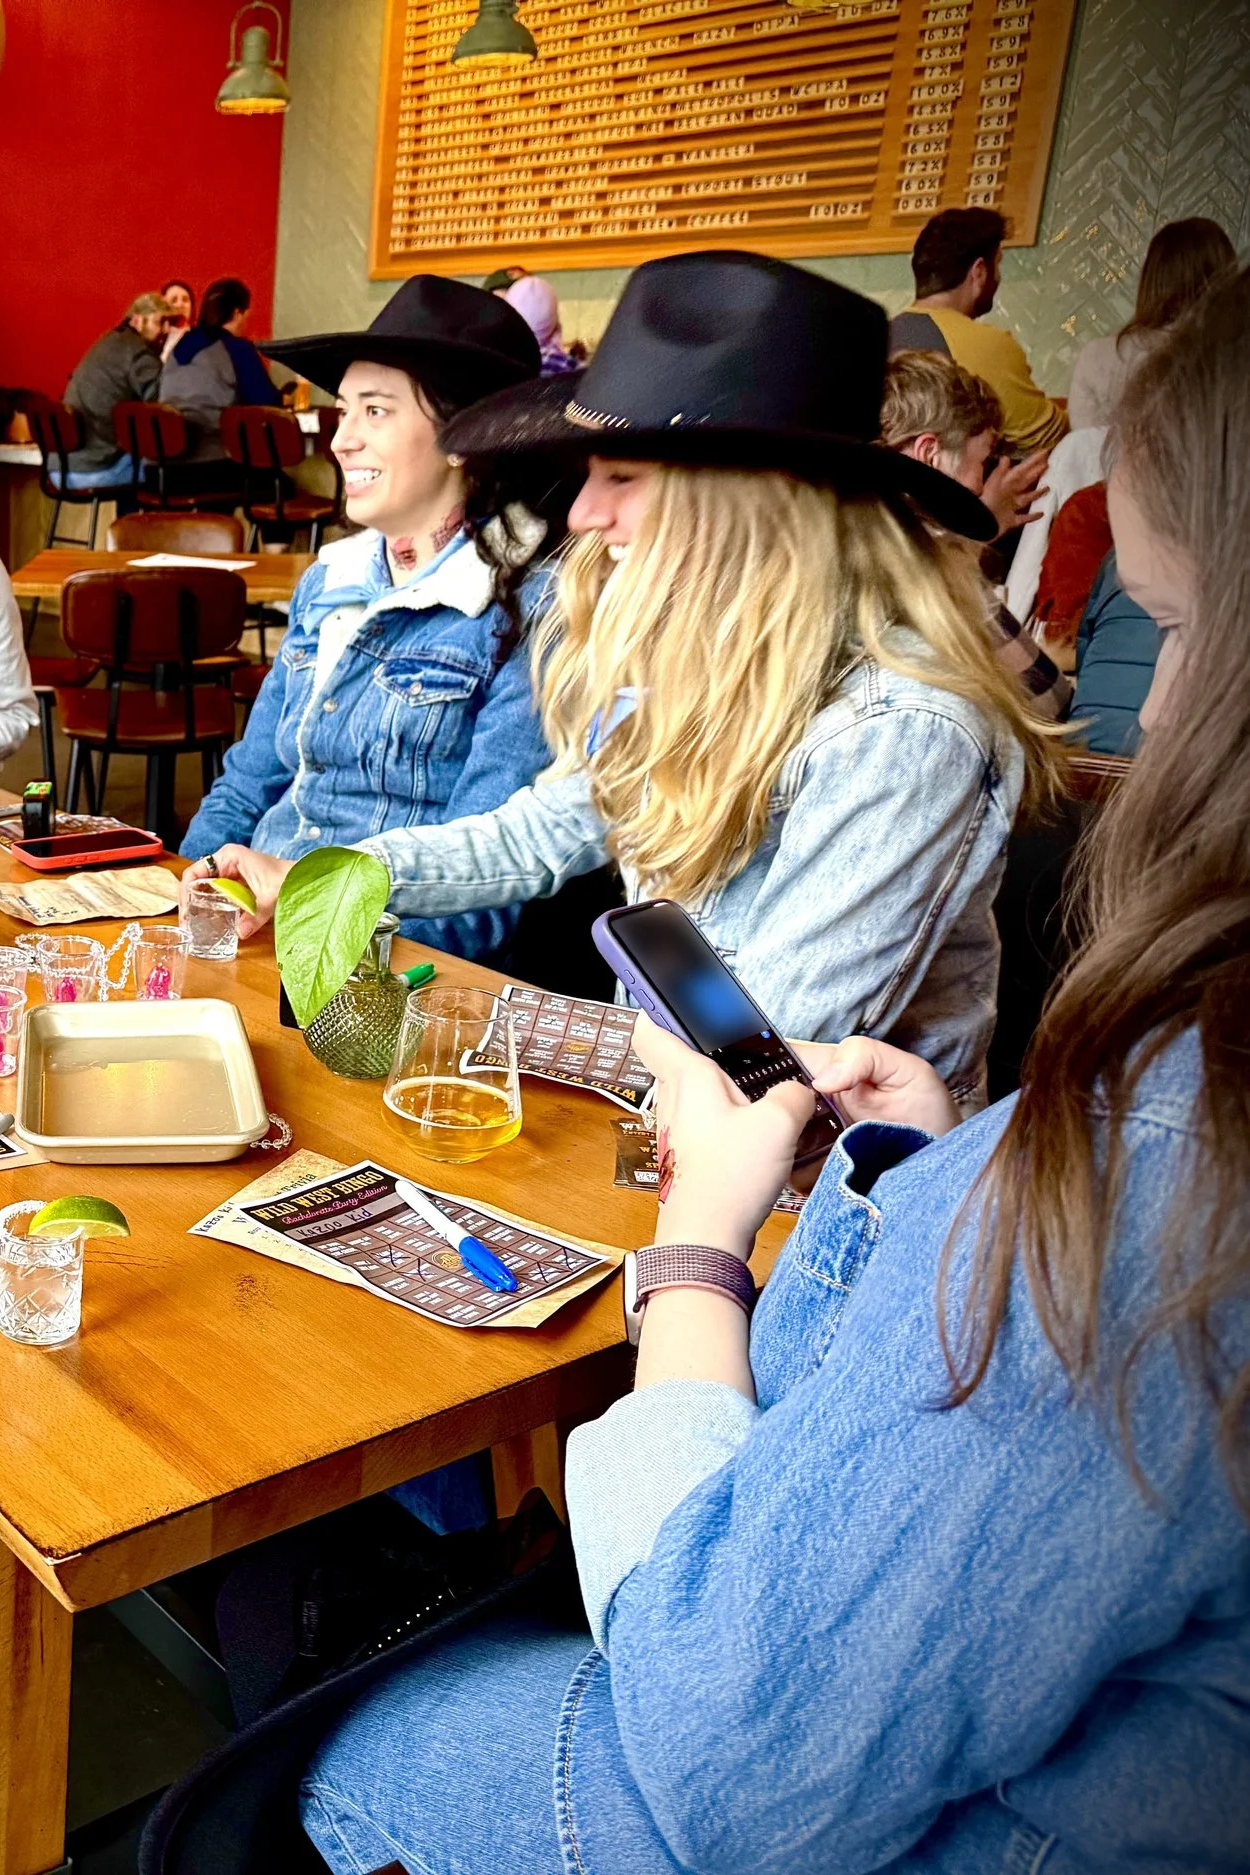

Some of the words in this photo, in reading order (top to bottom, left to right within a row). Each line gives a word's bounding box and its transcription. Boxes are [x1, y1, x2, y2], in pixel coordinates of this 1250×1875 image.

[537, 1066, 585, 1084] WEST
[591, 1080, 637, 1103] WILD
[250, 1202, 299, 1221] WILD
[291, 1186, 340, 1208] WEST
[332, 1170, 385, 1195] BINGO
[281, 1205, 333, 1225] Bachelorette
[332, 1195, 359, 1211] Party
[357, 1184, 388, 1200] Edition
